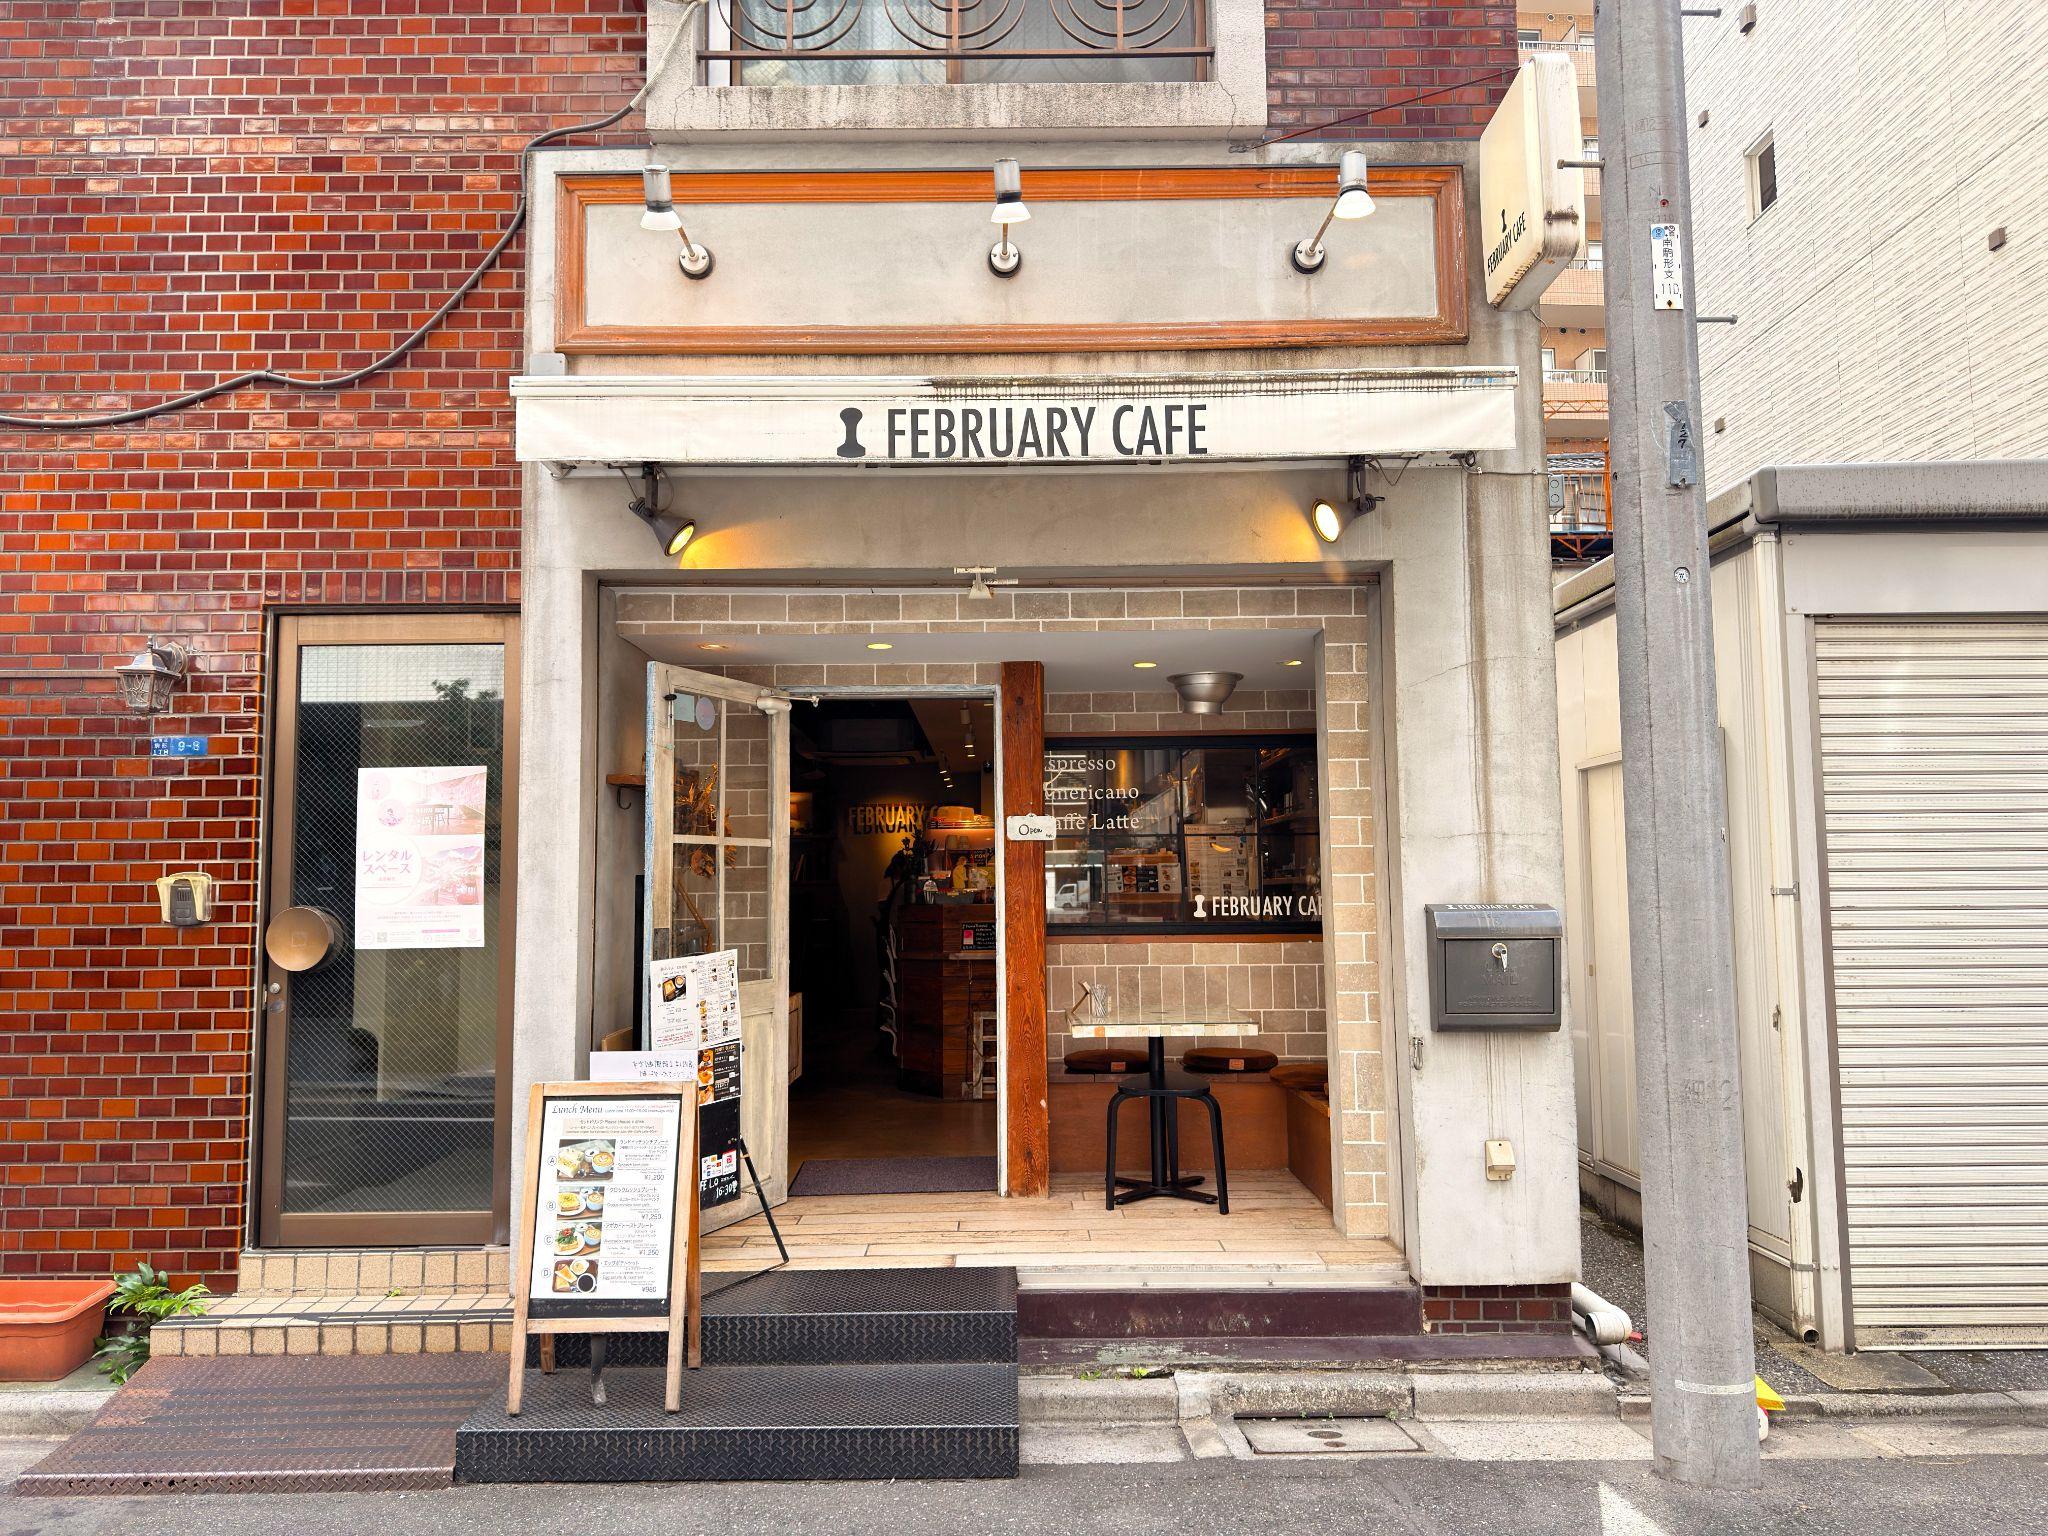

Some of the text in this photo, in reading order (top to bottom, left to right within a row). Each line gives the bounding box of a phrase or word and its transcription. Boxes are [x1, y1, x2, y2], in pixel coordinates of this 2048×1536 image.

[1487, 211, 1527, 277] FEBRUARY CAFE
[887, 403, 1208, 458] FEBRUARY CAFE
[1045, 758, 1116, 773] spresso
[849, 805, 925, 829] FEBRUARY
[1055, 813, 1141, 830] affè Latte
[1018, 824, 1043, 836] Open
[362, 849, 413, 862] レンタル
[363, 863, 411, 875] スペース
[1212, 895, 1292, 917] FEBRUARY
[552, 1102, 577, 1114] Lunch
[579, 1105, 603, 1114] Menu
